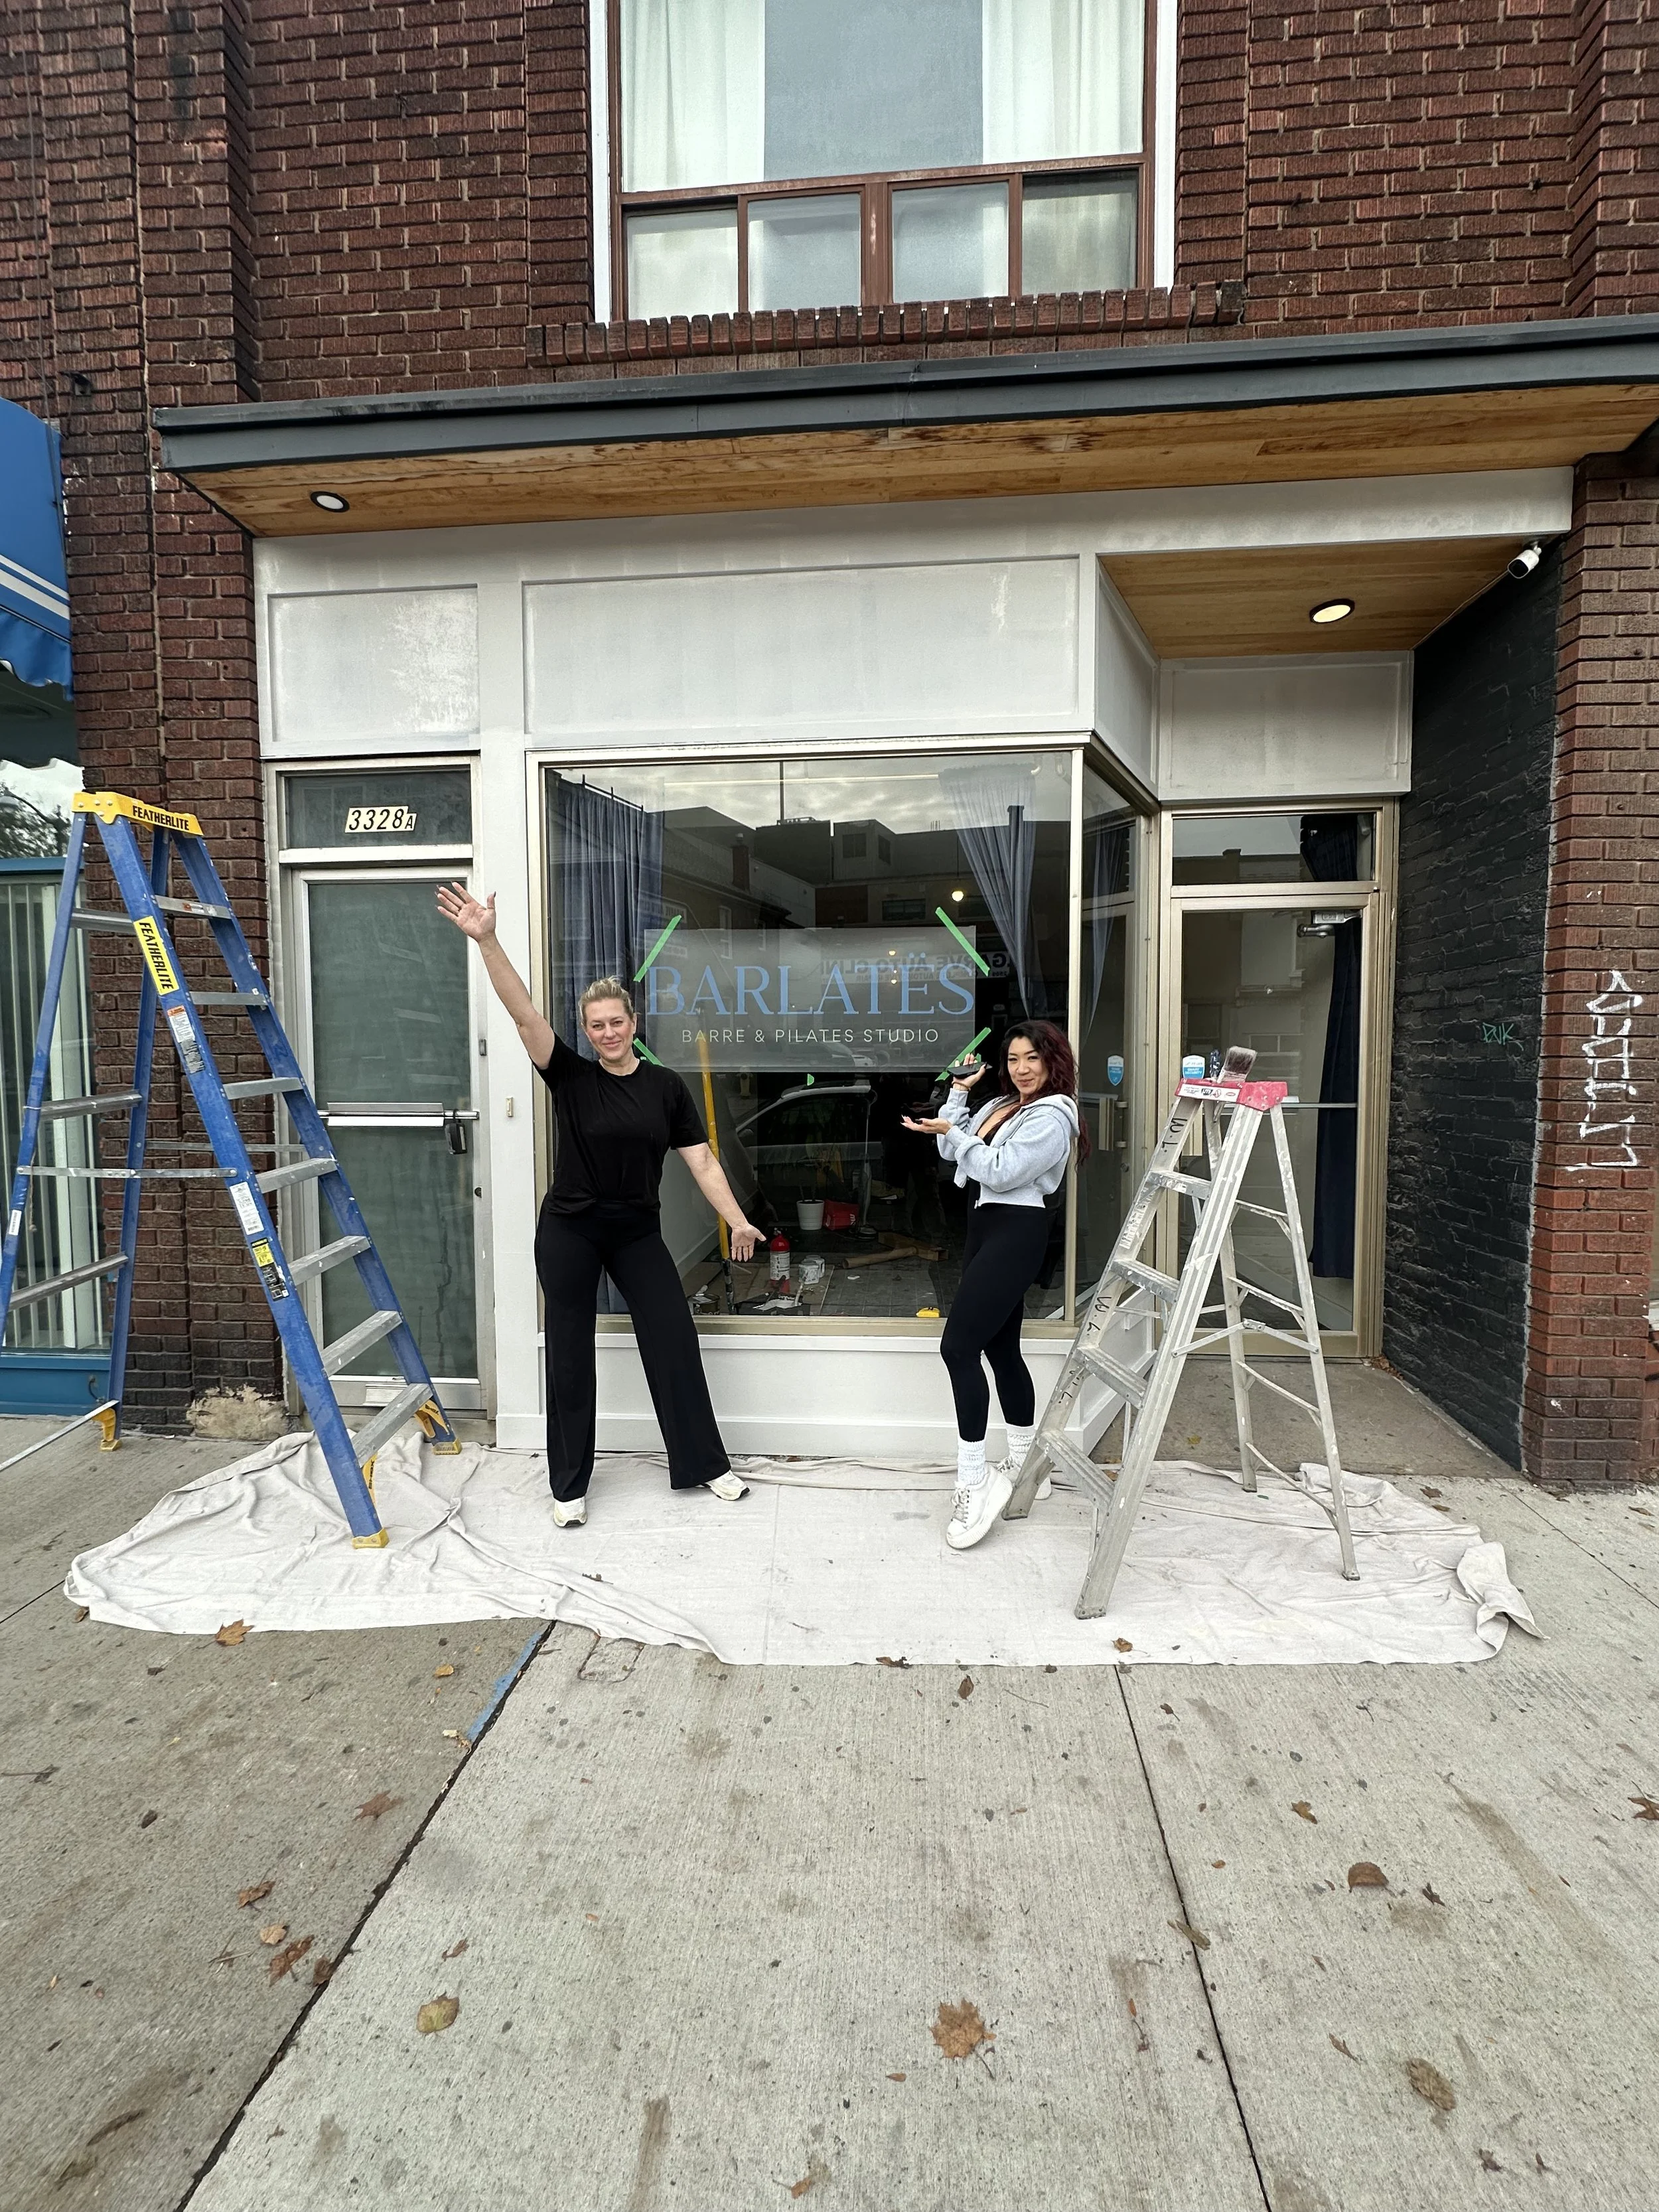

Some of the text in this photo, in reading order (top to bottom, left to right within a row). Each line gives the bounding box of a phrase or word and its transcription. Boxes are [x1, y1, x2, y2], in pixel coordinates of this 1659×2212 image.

[132, 805, 190, 830] FEATHERLITE
[139, 922, 174, 990] FEATHERLITE
[682, 1029, 938, 1043] BARRE & PILATES STUDIO
